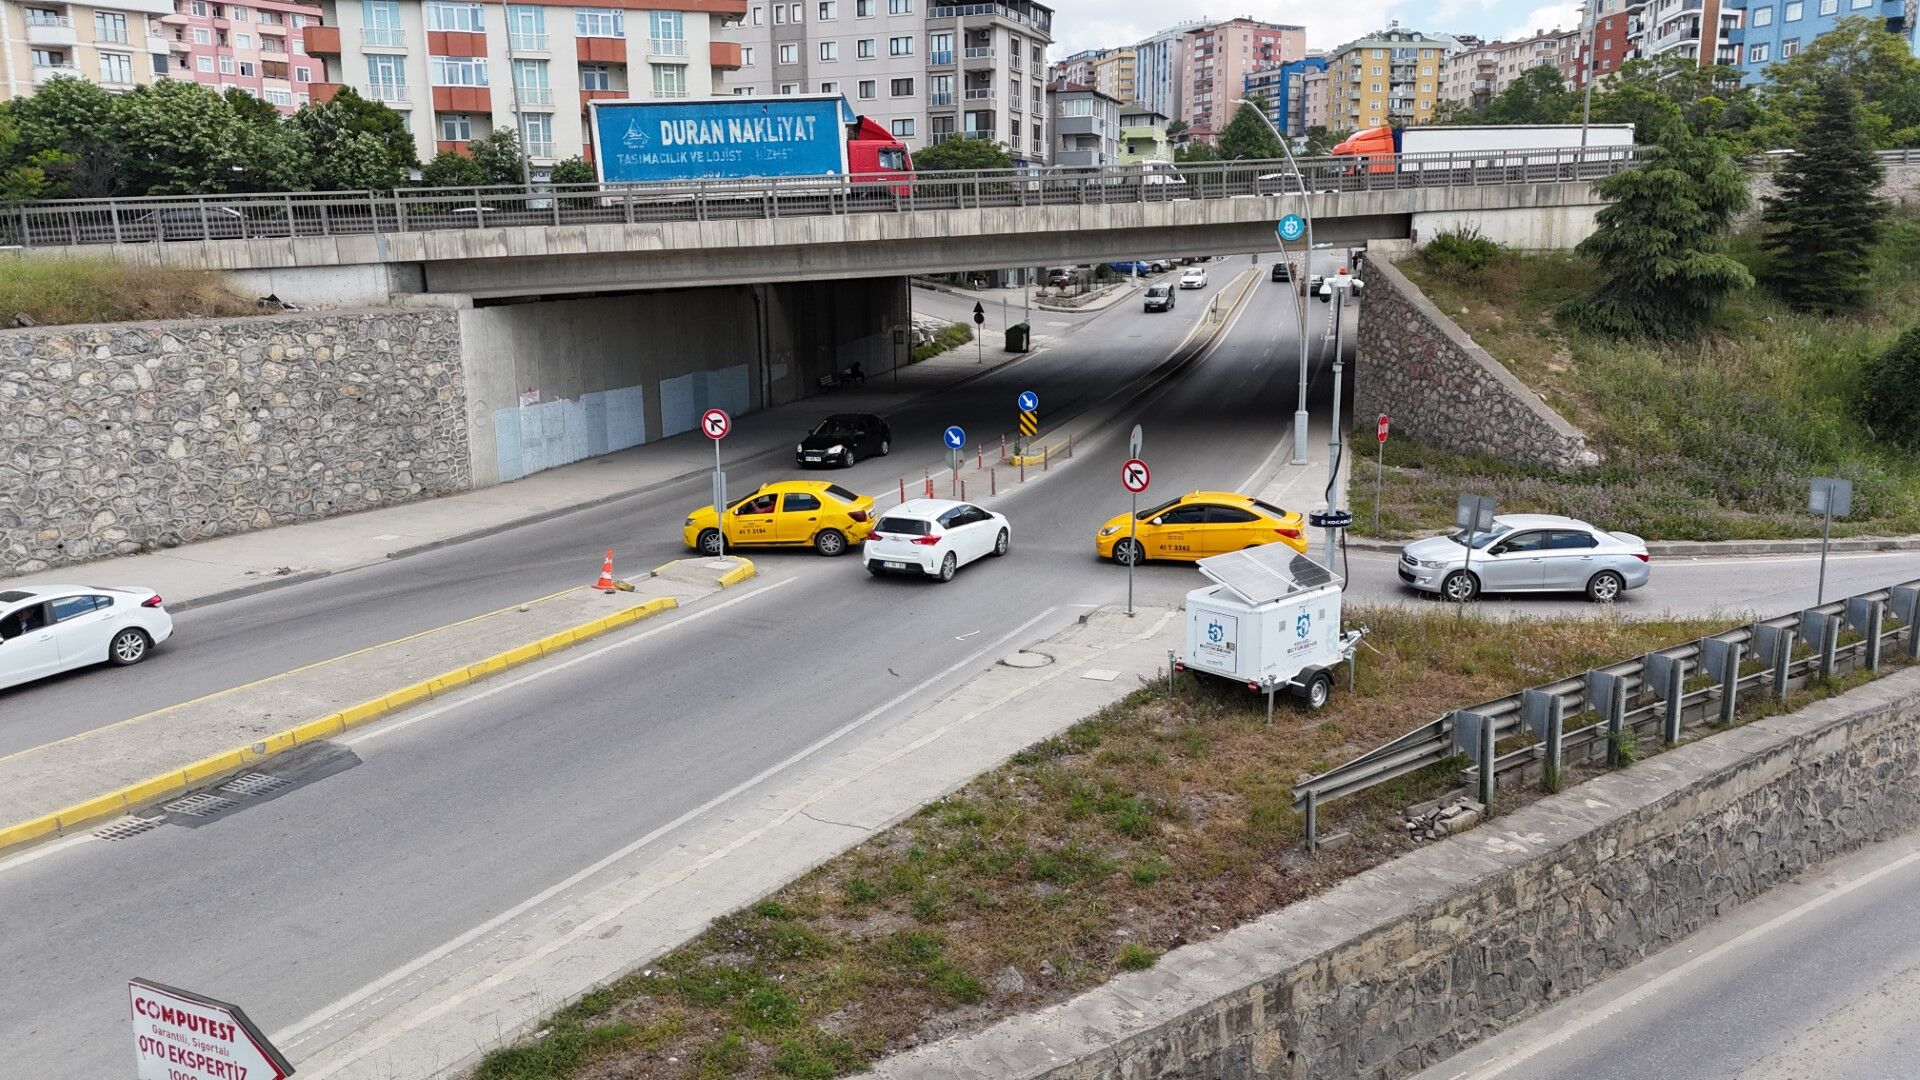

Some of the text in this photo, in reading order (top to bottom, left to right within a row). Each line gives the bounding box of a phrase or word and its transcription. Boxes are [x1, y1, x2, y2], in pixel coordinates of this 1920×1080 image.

[659, 115, 816, 146] DURAN NAKLİYAT
[689, 150, 704, 163] VE
[135, 997, 235, 1043] COMPUTEST
[138, 1034, 248, 1080] OTO EKSPERTİZ
